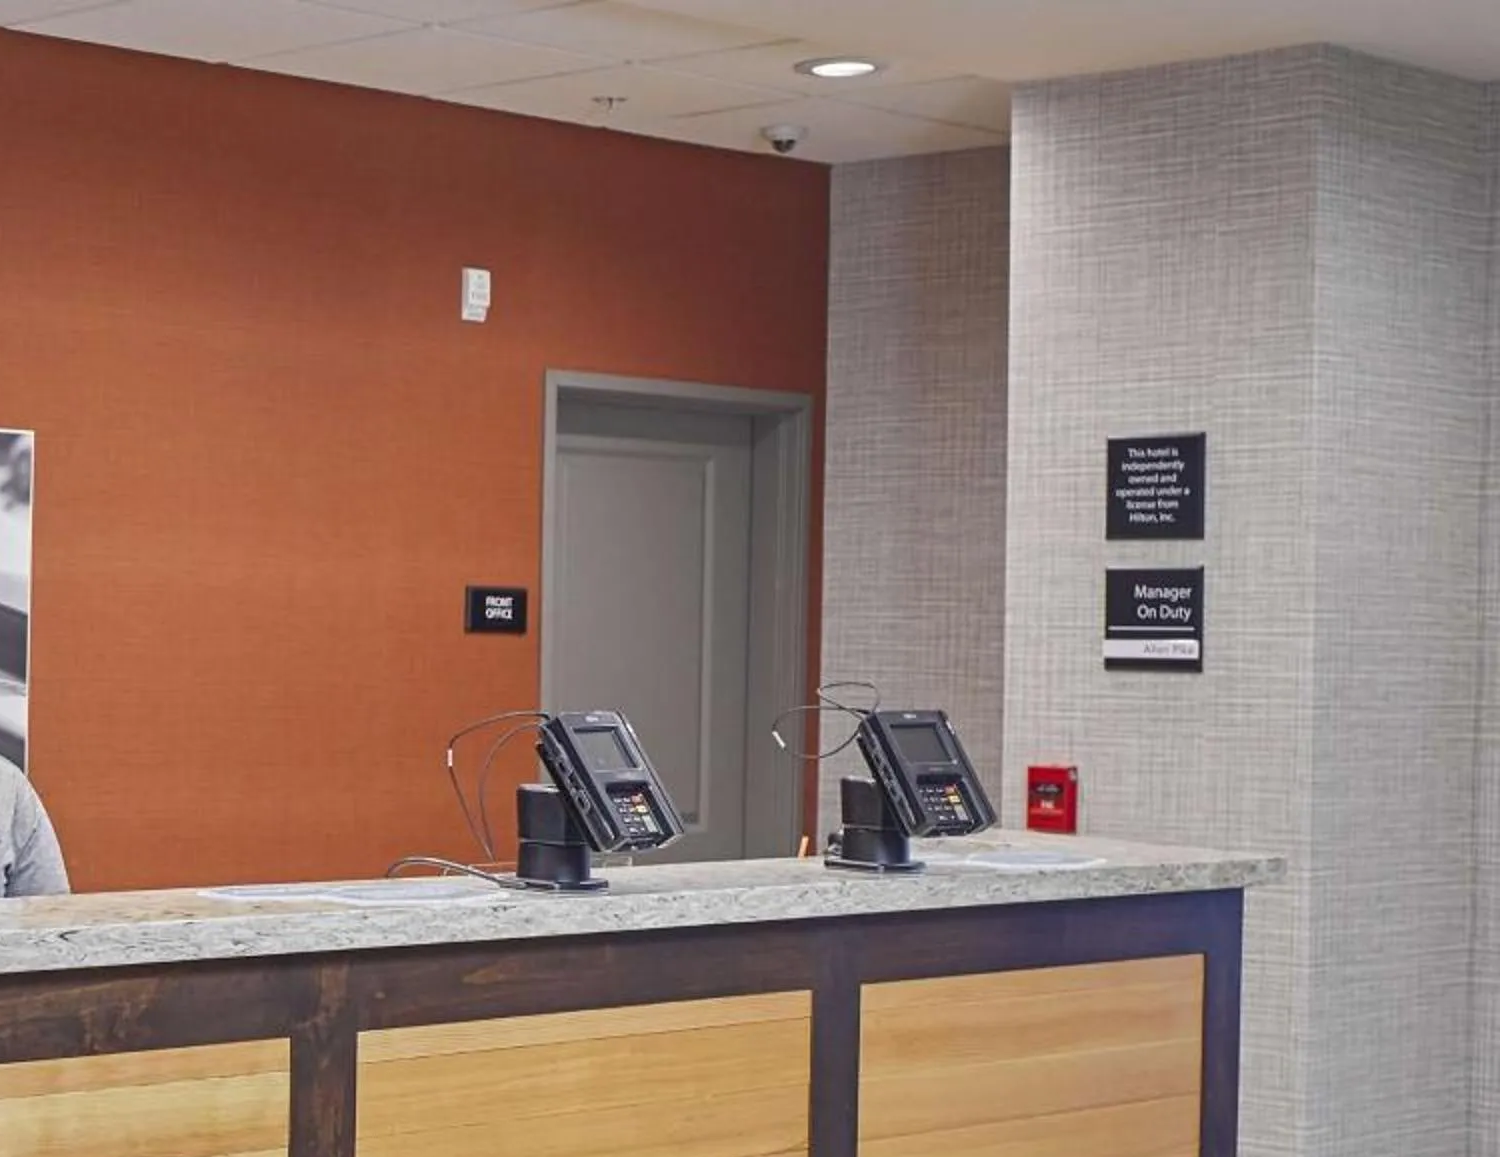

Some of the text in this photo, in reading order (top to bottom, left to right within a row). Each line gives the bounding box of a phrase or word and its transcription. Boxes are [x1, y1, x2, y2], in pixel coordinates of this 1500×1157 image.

[1127, 447, 1179, 458] This hotel is
[1127, 473, 1177, 484] owned and
[1115, 486, 1191, 499] operated under a
[1157, 499, 1179, 509] from
[1133, 583, 1192, 603] Manager
[485, 596, 513, 607] FRONT
[485, 607, 513, 619] OFFICE
[1137, 603, 1192, 623] On Duty
